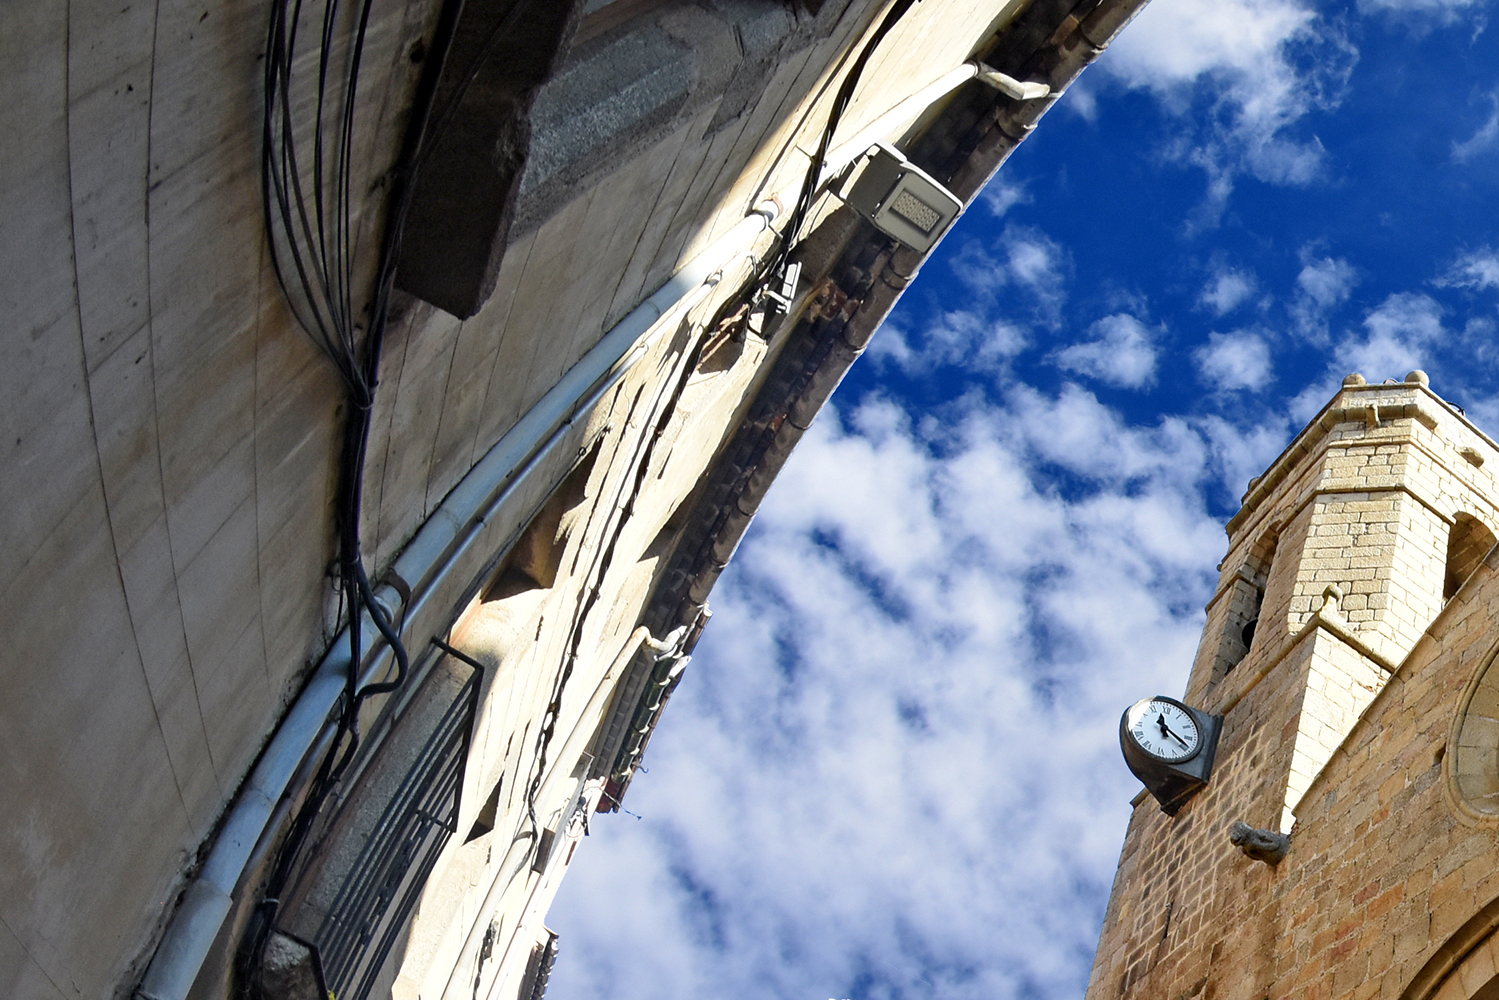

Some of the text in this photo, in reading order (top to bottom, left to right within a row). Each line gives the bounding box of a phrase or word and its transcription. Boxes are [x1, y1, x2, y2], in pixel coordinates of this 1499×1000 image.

[1149, 705, 1157, 713] XI
[1162, 705, 1171, 715] XII
[1134, 731, 1144, 740] VIII
[1142, 740, 1152, 750] VII
[1157, 747, 1165, 756] VI
[1172, 749, 1178, 757] V
